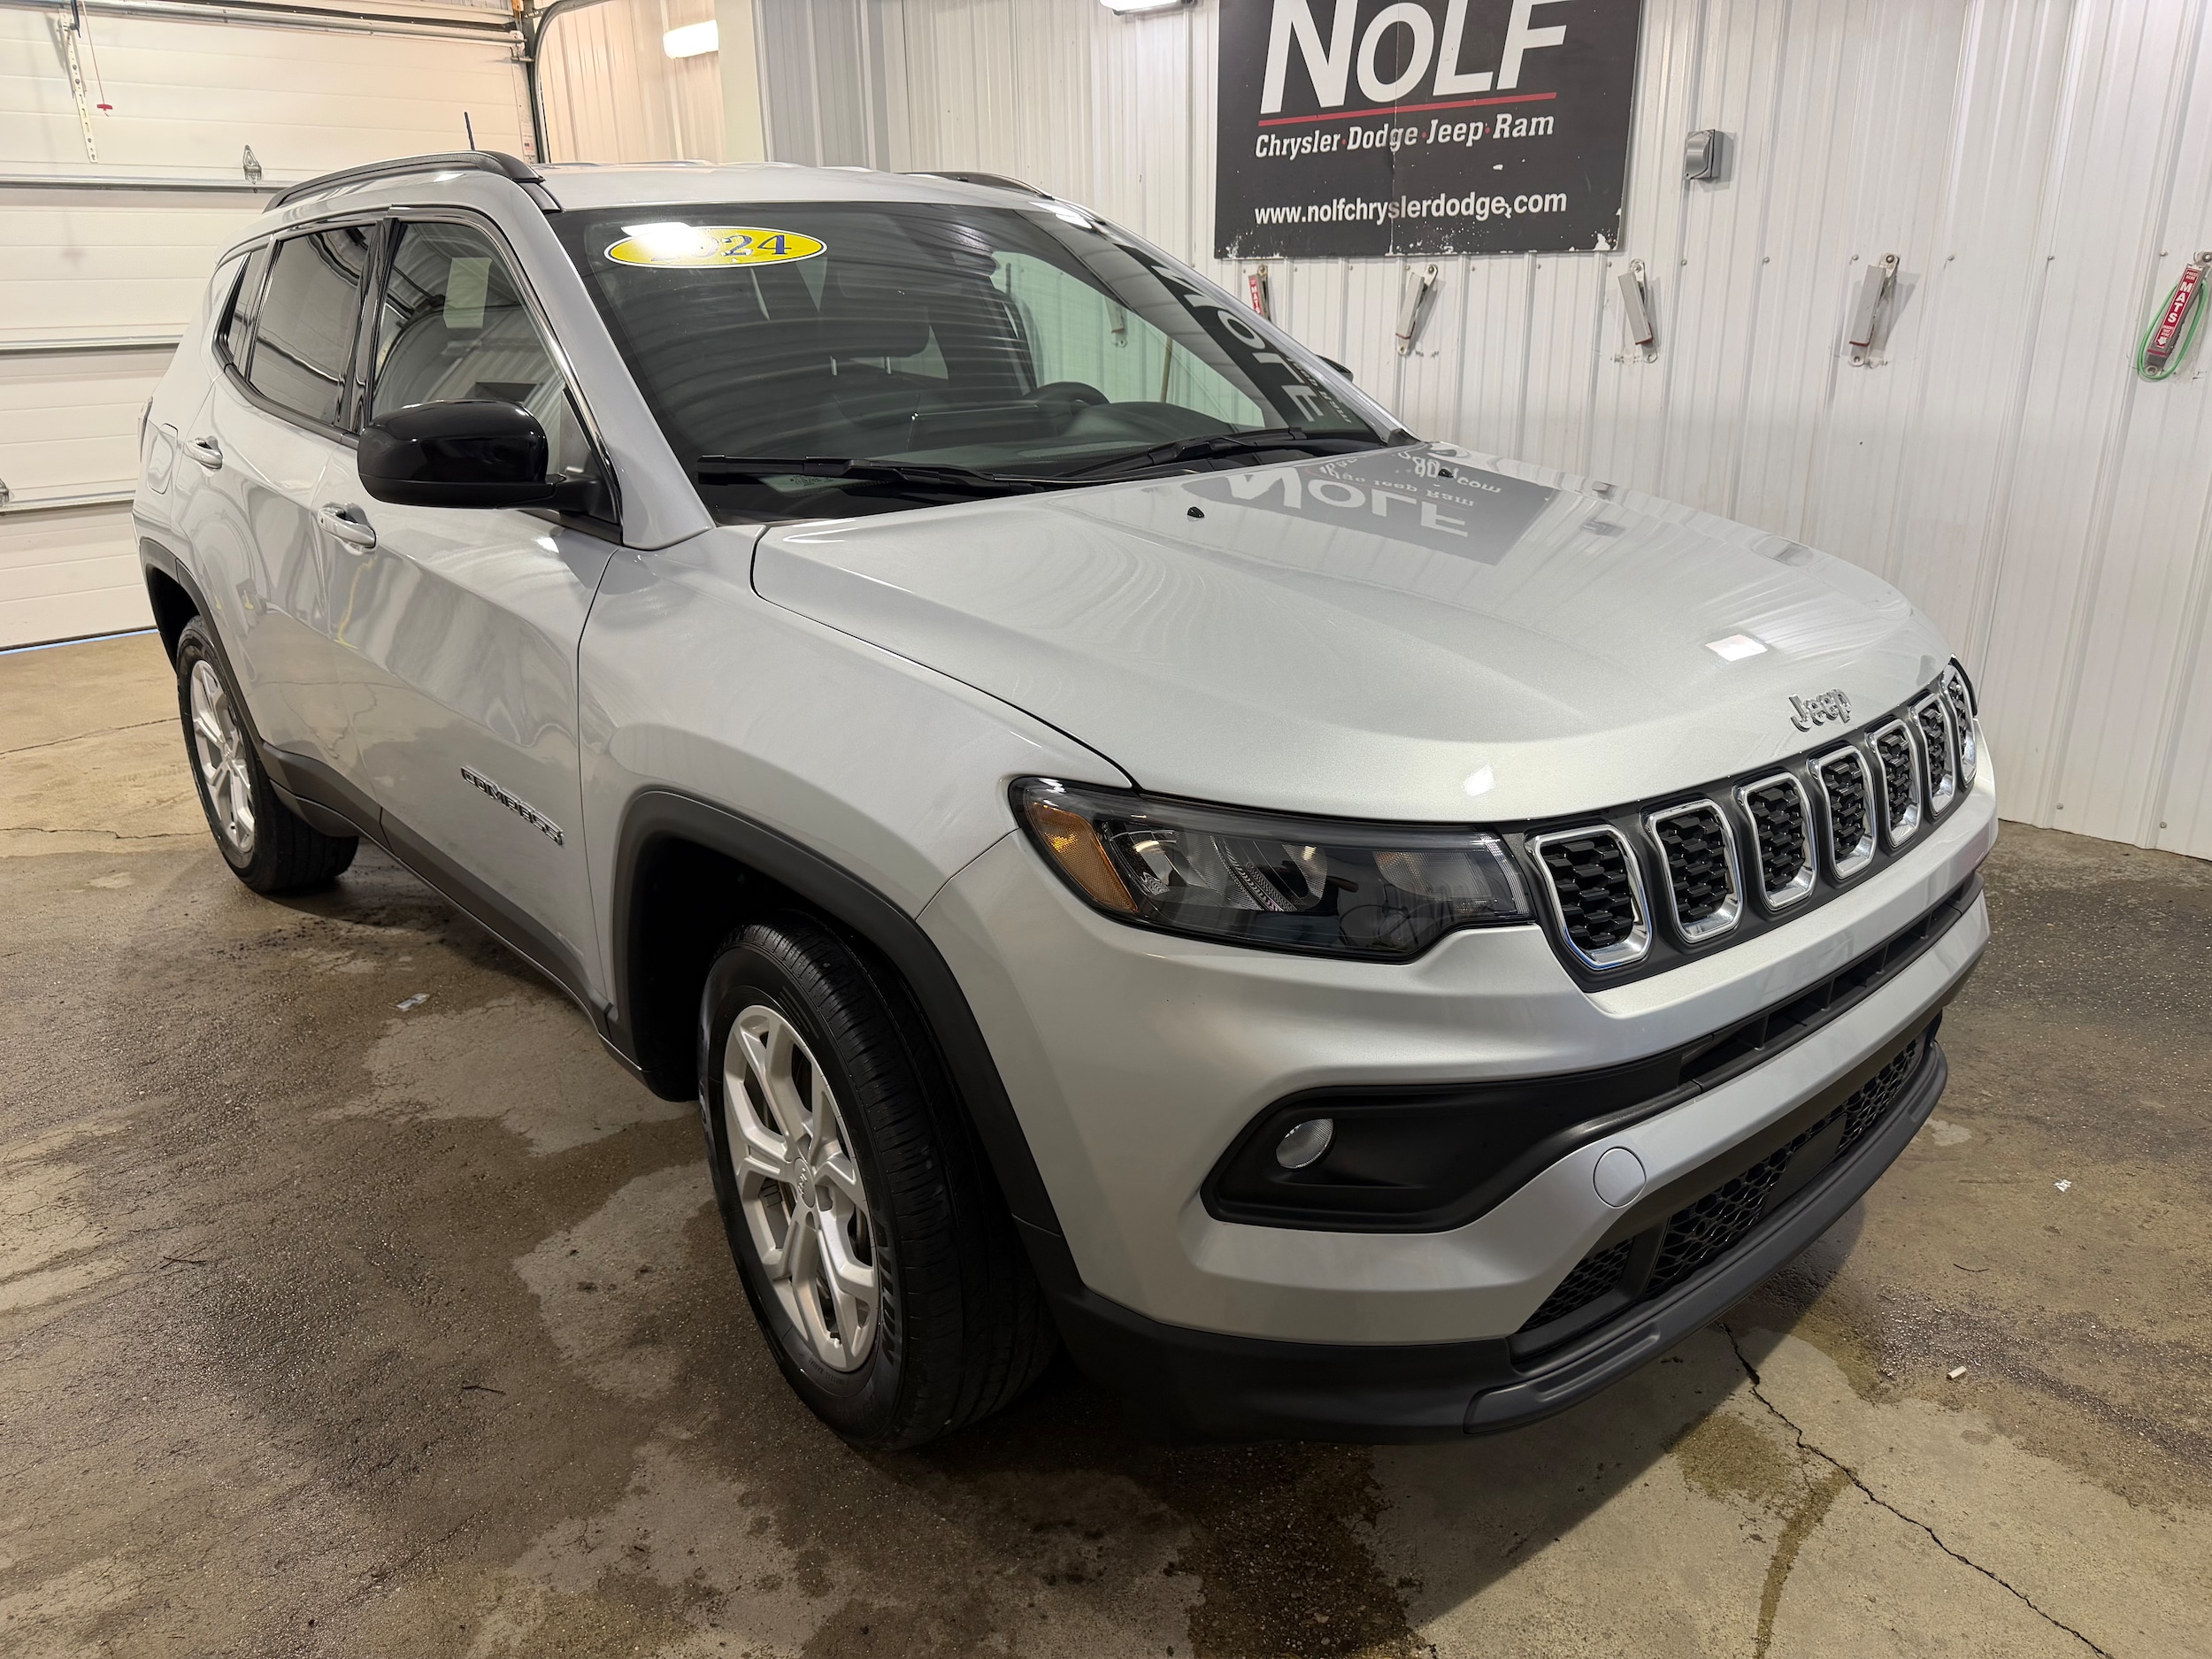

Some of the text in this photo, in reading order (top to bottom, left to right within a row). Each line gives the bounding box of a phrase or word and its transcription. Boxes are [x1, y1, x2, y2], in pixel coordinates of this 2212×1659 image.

[1260, 0, 1568, 114] NOLF
[1255, 112, 1555, 160] Chrysler Dodge Jeep Ram
[1254, 191, 1568, 226] www.nolfchryslerdodge.com
[651, 234, 792, 263] 024
[1251, 286, 1261, 314] MATS
[2168, 281, 2193, 323] MATS
[1788, 688, 1852, 732] Jeep
